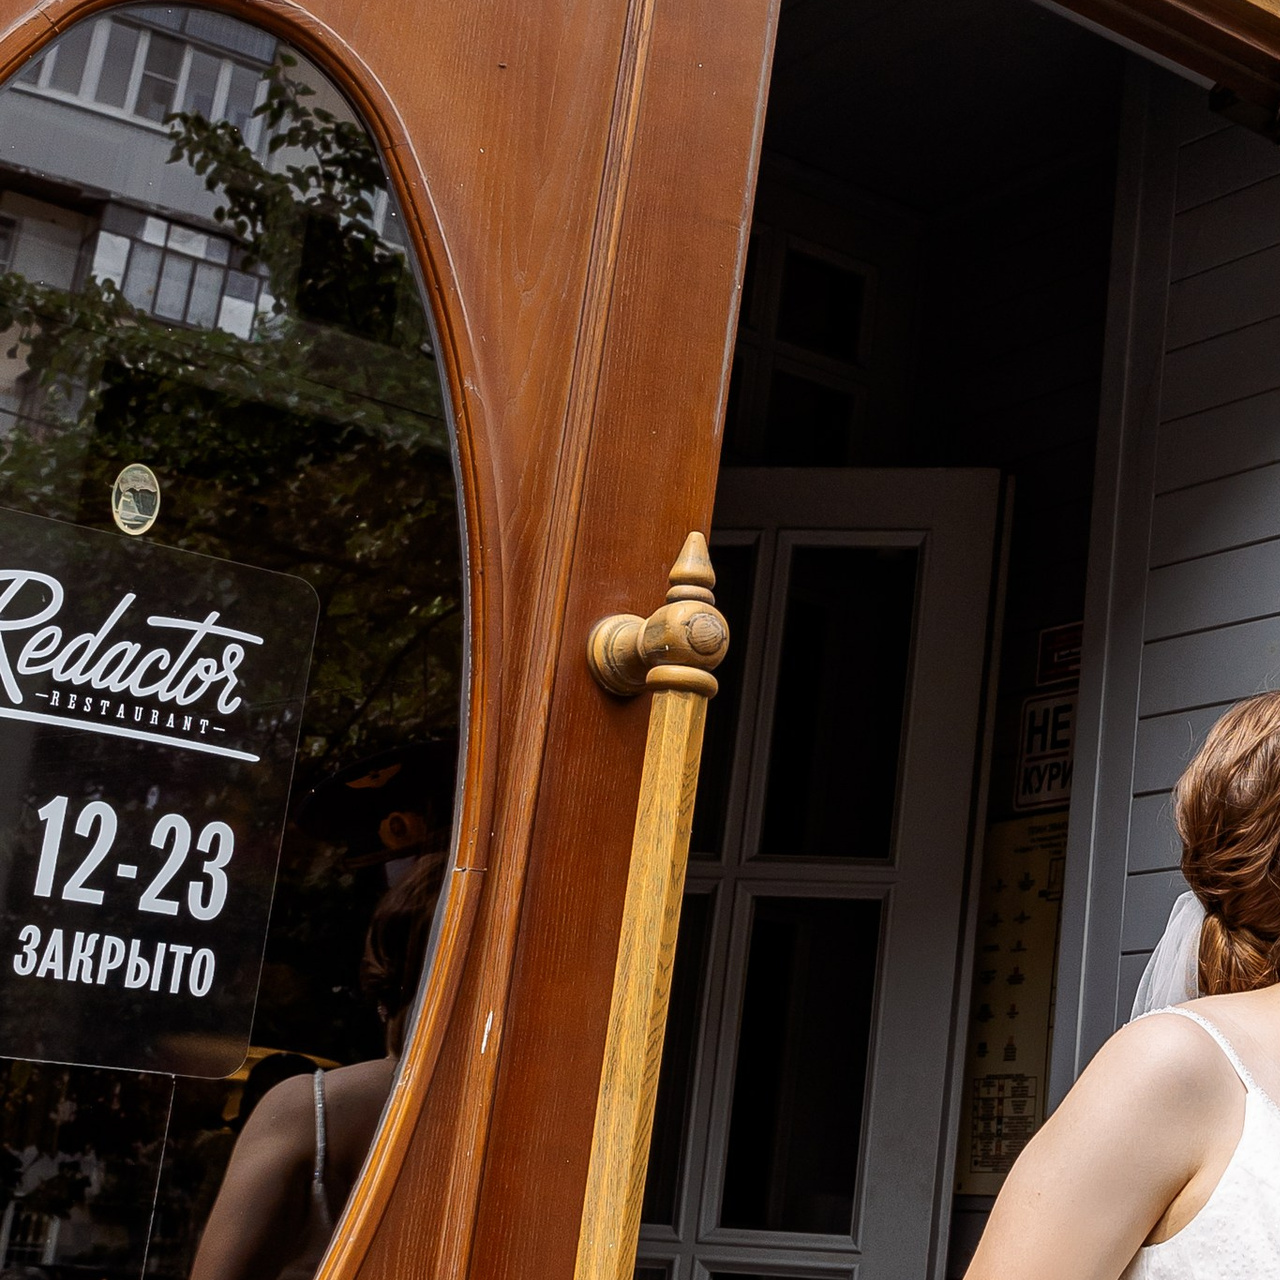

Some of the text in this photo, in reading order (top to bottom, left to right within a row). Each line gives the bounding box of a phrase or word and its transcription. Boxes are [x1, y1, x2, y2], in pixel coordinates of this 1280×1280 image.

[0, 570, 264, 715] Redactor
[50, 690, 210, 734] RESTAURANT
[1025, 703, 1074, 755] НЕ
[33, 795, 235, 921] 12-23
[13, 924, 216, 998] ЗАКРЫТО
